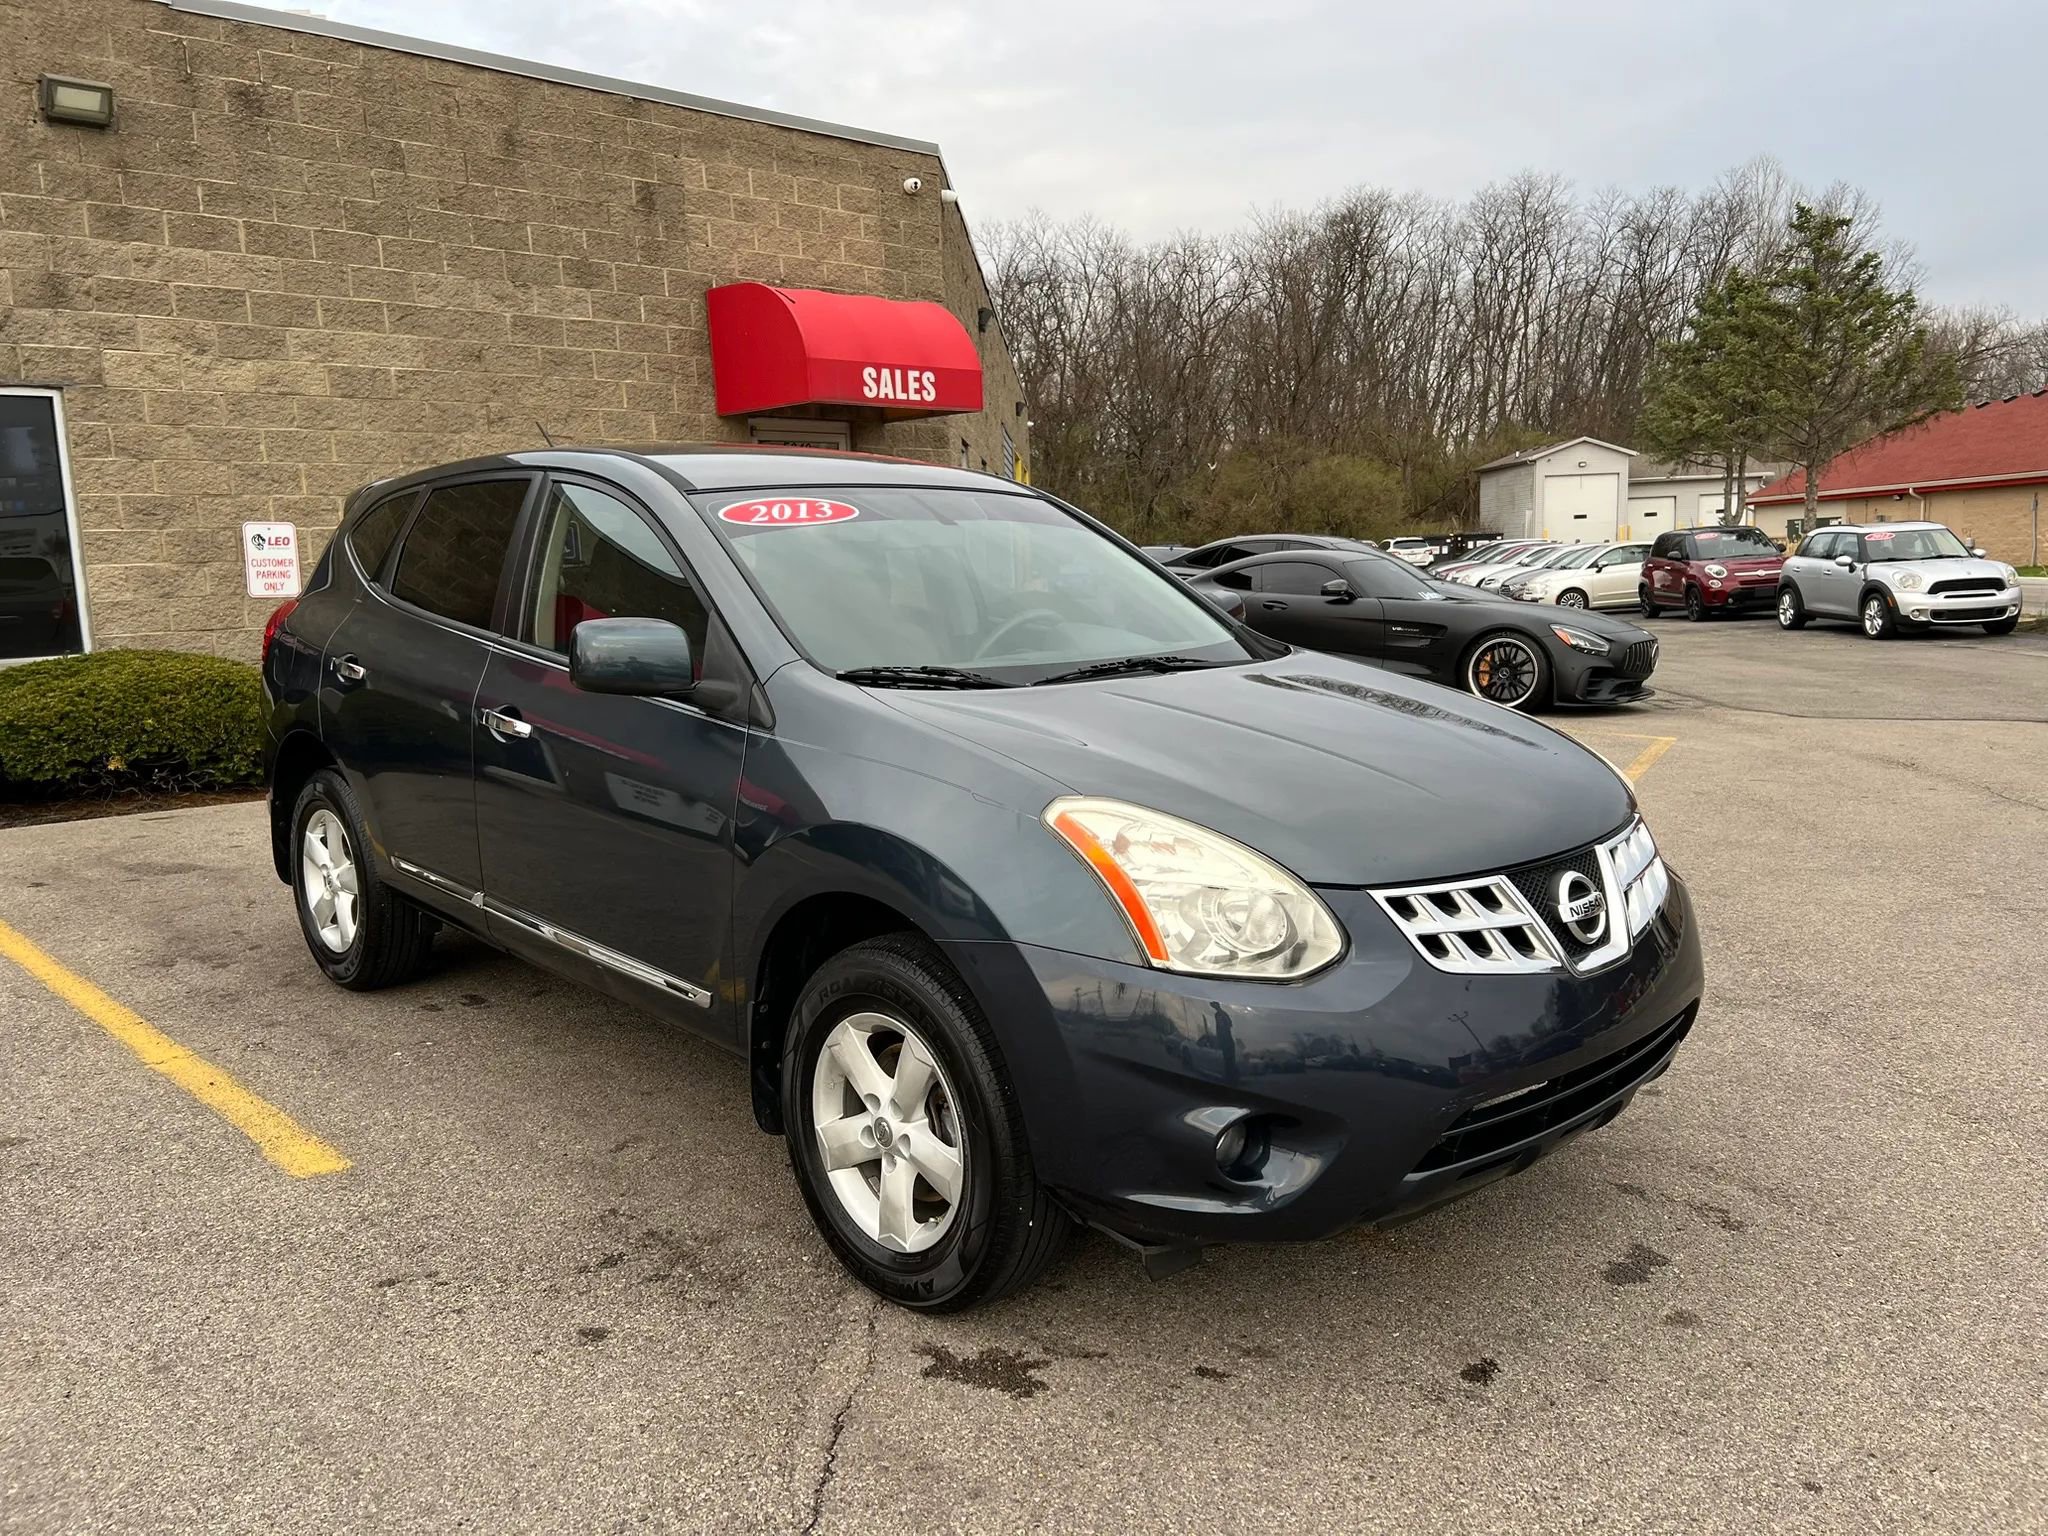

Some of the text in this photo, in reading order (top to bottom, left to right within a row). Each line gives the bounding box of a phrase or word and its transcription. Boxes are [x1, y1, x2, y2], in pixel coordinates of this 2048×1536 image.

[862, 366, 937, 402] SALES
[750, 502, 833, 522] 2013
[267, 536, 290, 546] LEO
[251, 558, 294, 567] CUSTOMER
[256, 570, 291, 579] PARKING
[264, 582, 285, 591] ONLY
[1569, 896, 1603, 918] NISSA
